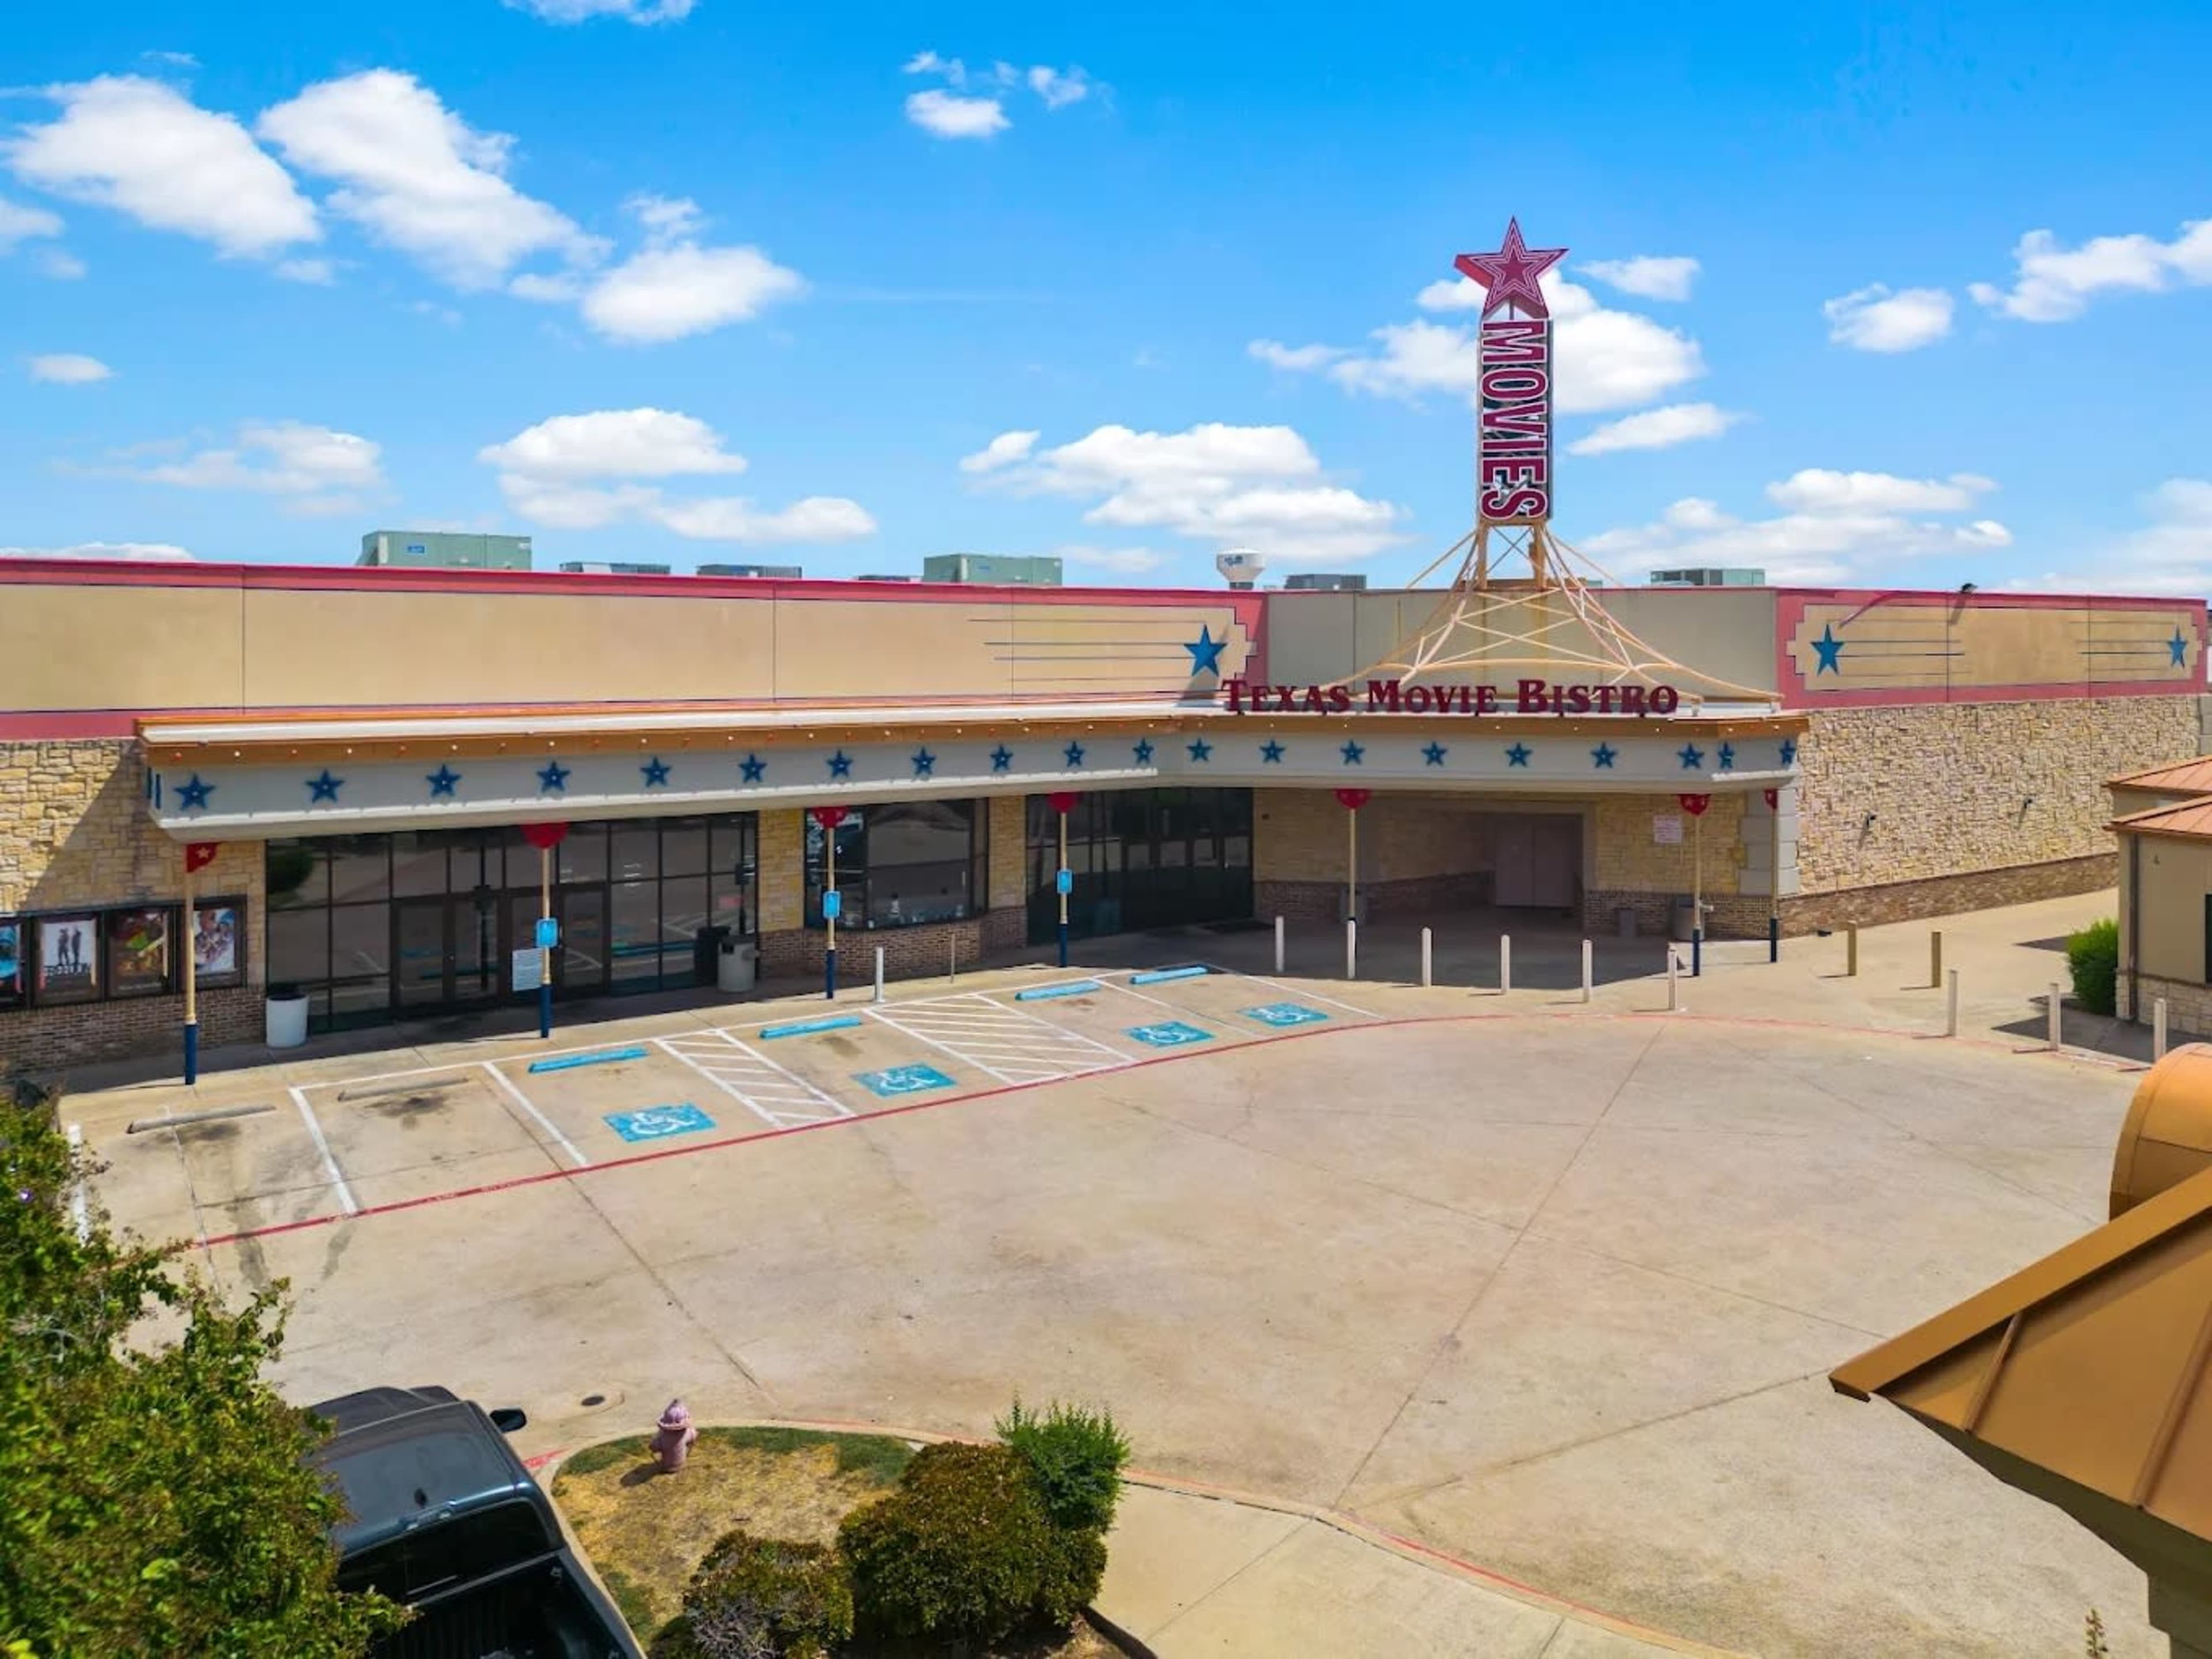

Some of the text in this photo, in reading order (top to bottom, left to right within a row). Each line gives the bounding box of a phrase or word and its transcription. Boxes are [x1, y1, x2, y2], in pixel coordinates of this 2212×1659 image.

[1482, 320, 1548, 518] MOVIES
[1223, 679, 1679, 714] TEXAS MOVIE BISTRO
